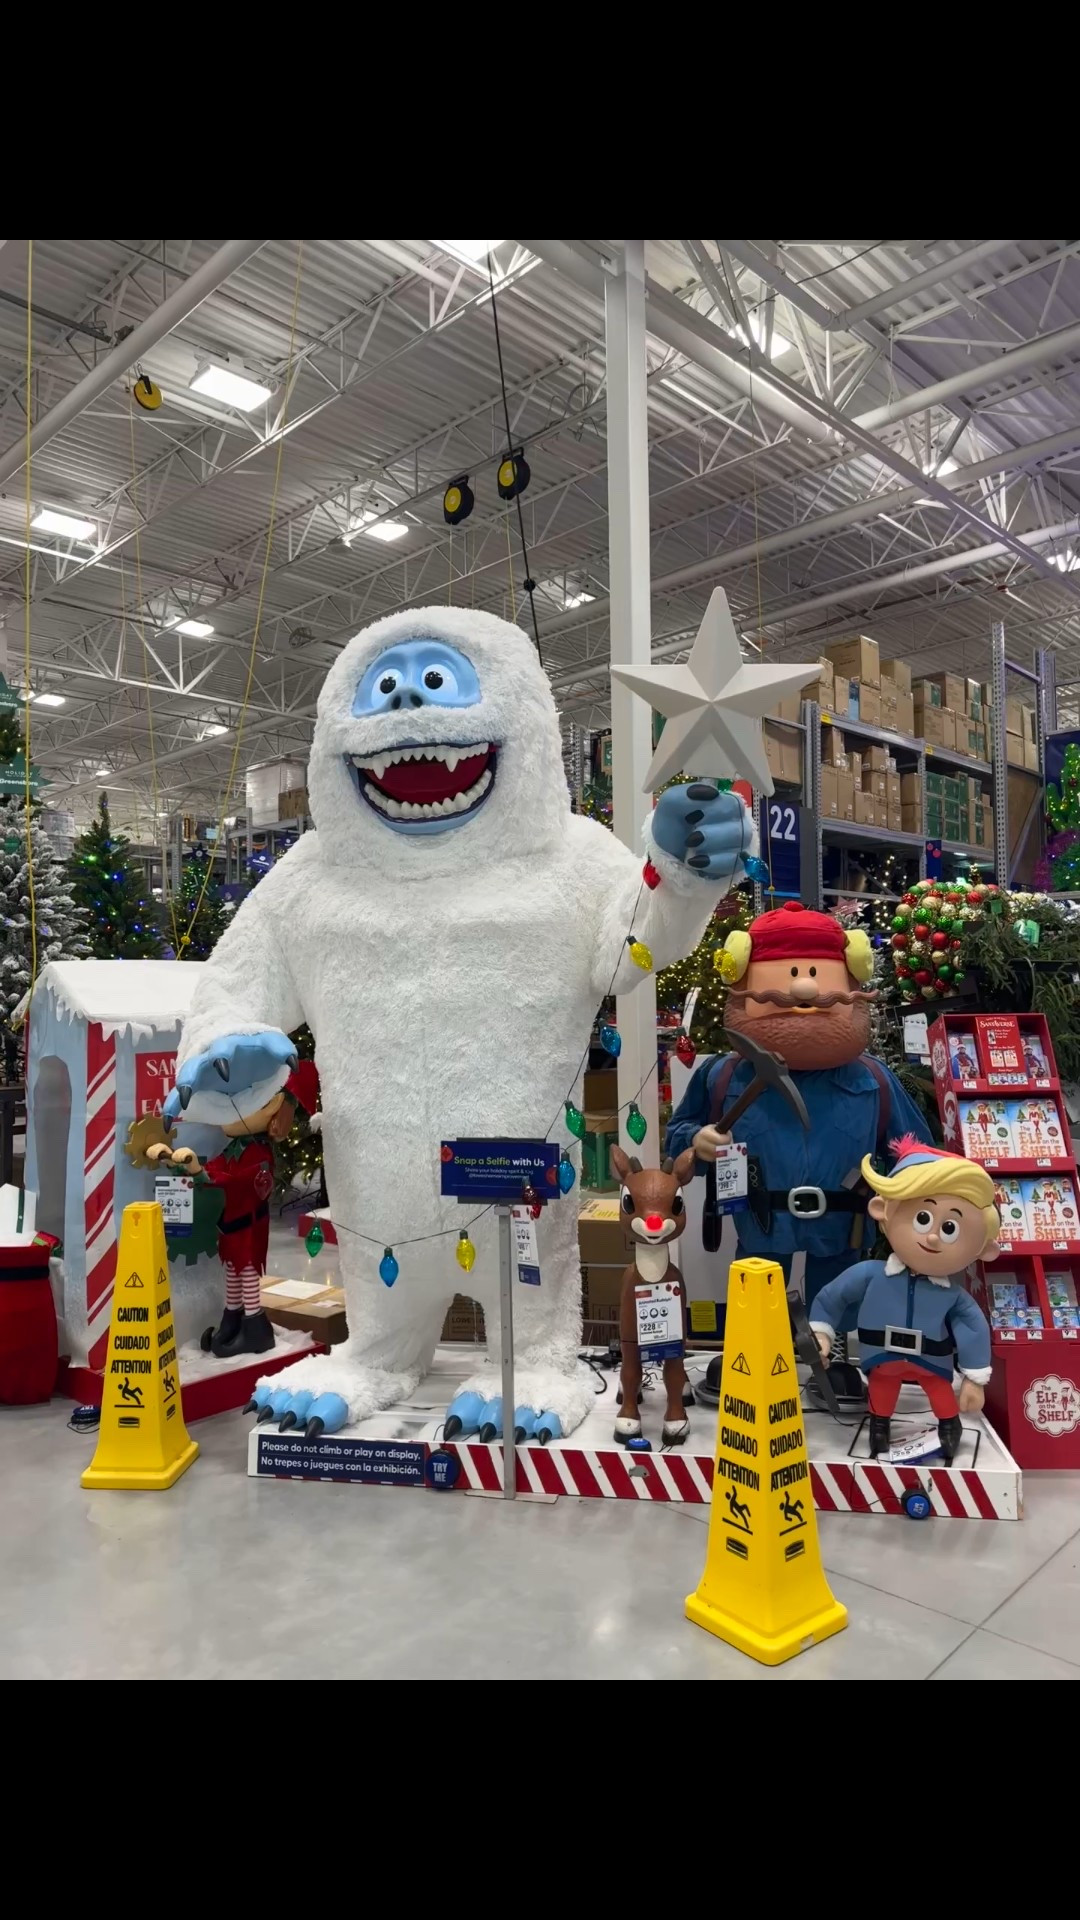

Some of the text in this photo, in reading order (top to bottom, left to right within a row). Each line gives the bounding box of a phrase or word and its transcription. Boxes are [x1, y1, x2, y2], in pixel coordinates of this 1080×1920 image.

[770, 805, 796, 841] 22
[454, 1156, 476, 1165] Snap
[486, 1157, 510, 1165] Selfie
[512, 1158, 532, 1167] with
[533, 1158, 545, 1167] Us
[118, 1307, 149, 1322] CAUTION
[114, 1335, 151, 1350] CUIDADO
[110, 1359, 152, 1374] ATTENTION
[1036, 1391, 1057, 1404] ELF
[723, 1393, 756, 1424] CAUTION
[768, 1397, 798, 1425] CAUTION
[1038, 1409, 1074, 1424] SHELF
[261, 1441, 420, 1460] Please do not climb or play on display.
[721, 1426, 758, 1457] CUIDADO
[769, 1428, 803, 1458] CUIDADO
[261, 1456, 273, 1466] No
[275, 1458, 302, 1469] trepes
[309, 1460, 344, 1471] juegues
[362, 1463, 372, 1472] la
[373, 1464, 421, 1475] exhibición.
[433, 1462, 448, 1473] TRY
[718, 1457, 760, 1492] ATTENTION
[434, 1473, 447, 1482] ME
[771, 1459, 808, 1492] ATTENTION
